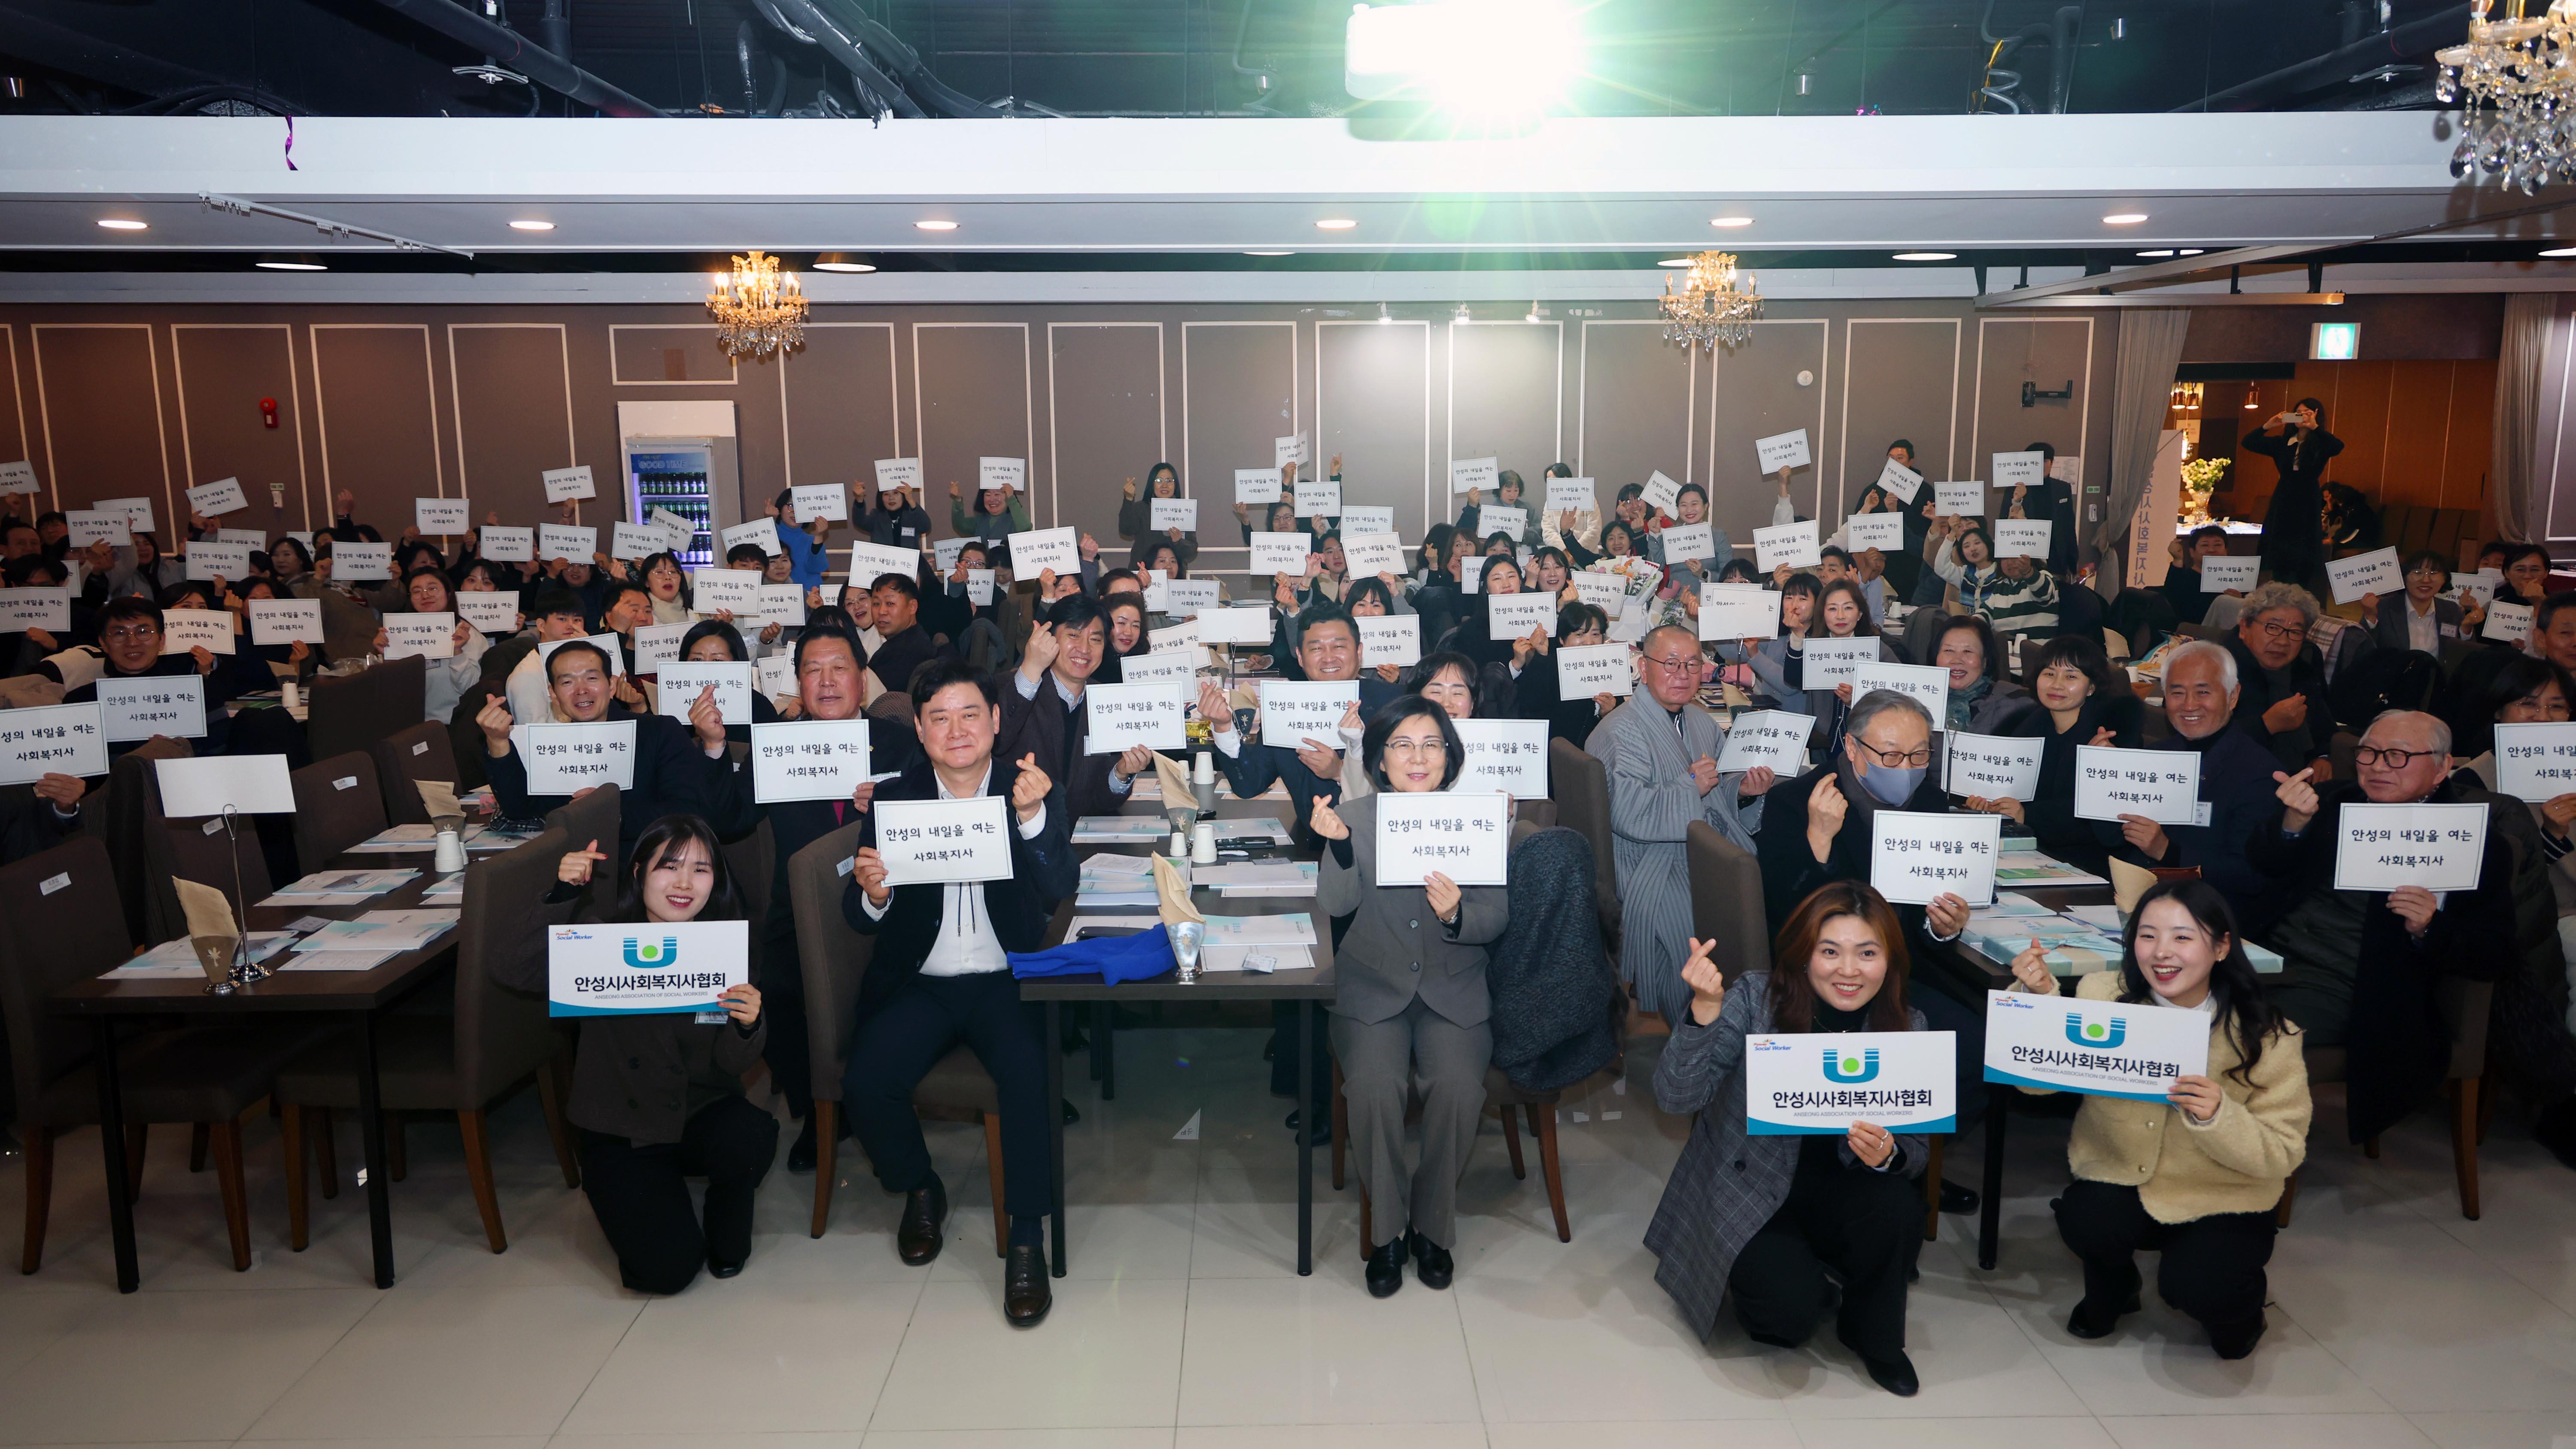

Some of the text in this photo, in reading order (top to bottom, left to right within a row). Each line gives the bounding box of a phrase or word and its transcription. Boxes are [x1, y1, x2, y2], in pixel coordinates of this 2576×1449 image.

[1774, 452, 1796, 460] 사회복지사
[1016, 545, 1034, 553] 안성의
[1760, 539, 1776, 547] 안성의
[1349, 547, 1366, 555] 안성의
[1773, 548, 1801, 557] 사회복지사
[1031, 555, 1060, 564] 사회복지사
[2335, 570, 2354, 579] 안성의
[2358, 564, 2377, 573] 내일을
[2351, 575, 2383, 587] 사회복지사
[1564, 662, 1584, 670] 안성의
[1589, 659, 1608, 668] 내일을
[1580, 674, 1612, 683] 사회복지사
[107, 693, 195, 705] 안성의 내일을 여는
[1096, 701, 1175, 714] 안성의 내일을 여는
[1269, 701, 1294, 711] 안성의
[1301, 702, 1327, 711] 내일을
[130, 712, 177, 721] 사회복지사
[1116, 721, 1159, 731] 사회복지사
[1288, 721, 1332, 731] 사회복지사
[1, 724, 95, 743] 성의 내일을 여는
[1734, 728, 1800, 740] 안성의 내일을 여는
[16, 747, 74, 761] 사회복지사
[536, 742, 627, 755] 안성의 내일을 여는
[763, 743, 859, 757] 안성의 내일을 여는
[1463, 743, 1539, 753] 성의 내일을 여는
[1741, 745, 1779, 755] 사회복지사
[2508, 746, 2576, 758] 안성의 내일
[1951, 750, 2033, 766] 안성의 내일을 여는
[559, 764, 608, 775] 사회복지사
[787, 766, 838, 777] 사회복지사
[1476, 766, 1522, 776] 사회복지사
[2535, 769, 2576, 780] 사회복
[1968, 772, 2013, 784] 사회복지사
[2086, 768, 2187, 784] 안성의 내일을 여는
[2108, 791, 2163, 803] 사회복지사
[886, 822, 995, 841] 안성의 내일을 여는
[1388, 819, 1495, 832] 안성의 내일을 여는
[2352, 829, 2473, 842] 안성의 내일을 여는
[1412, 845, 1470, 858] 사회복지사
[1885, 838, 1989, 854] 안성의 내일을 여는
[914, 848, 973, 862] 사회복지사
[2378, 855, 2444, 868] 사회복지사
[1910, 866, 1968, 880] 사회복지사
[574, 972, 726, 992] 안성시사회복지사협회
[2011, 1045, 2180, 1078] 안성시사회복지사협회
[2060, 1070, 2098, 1078] ASSOCIATION
[1773, 1089, 1932, 1108] 안성시사회복지사협회
